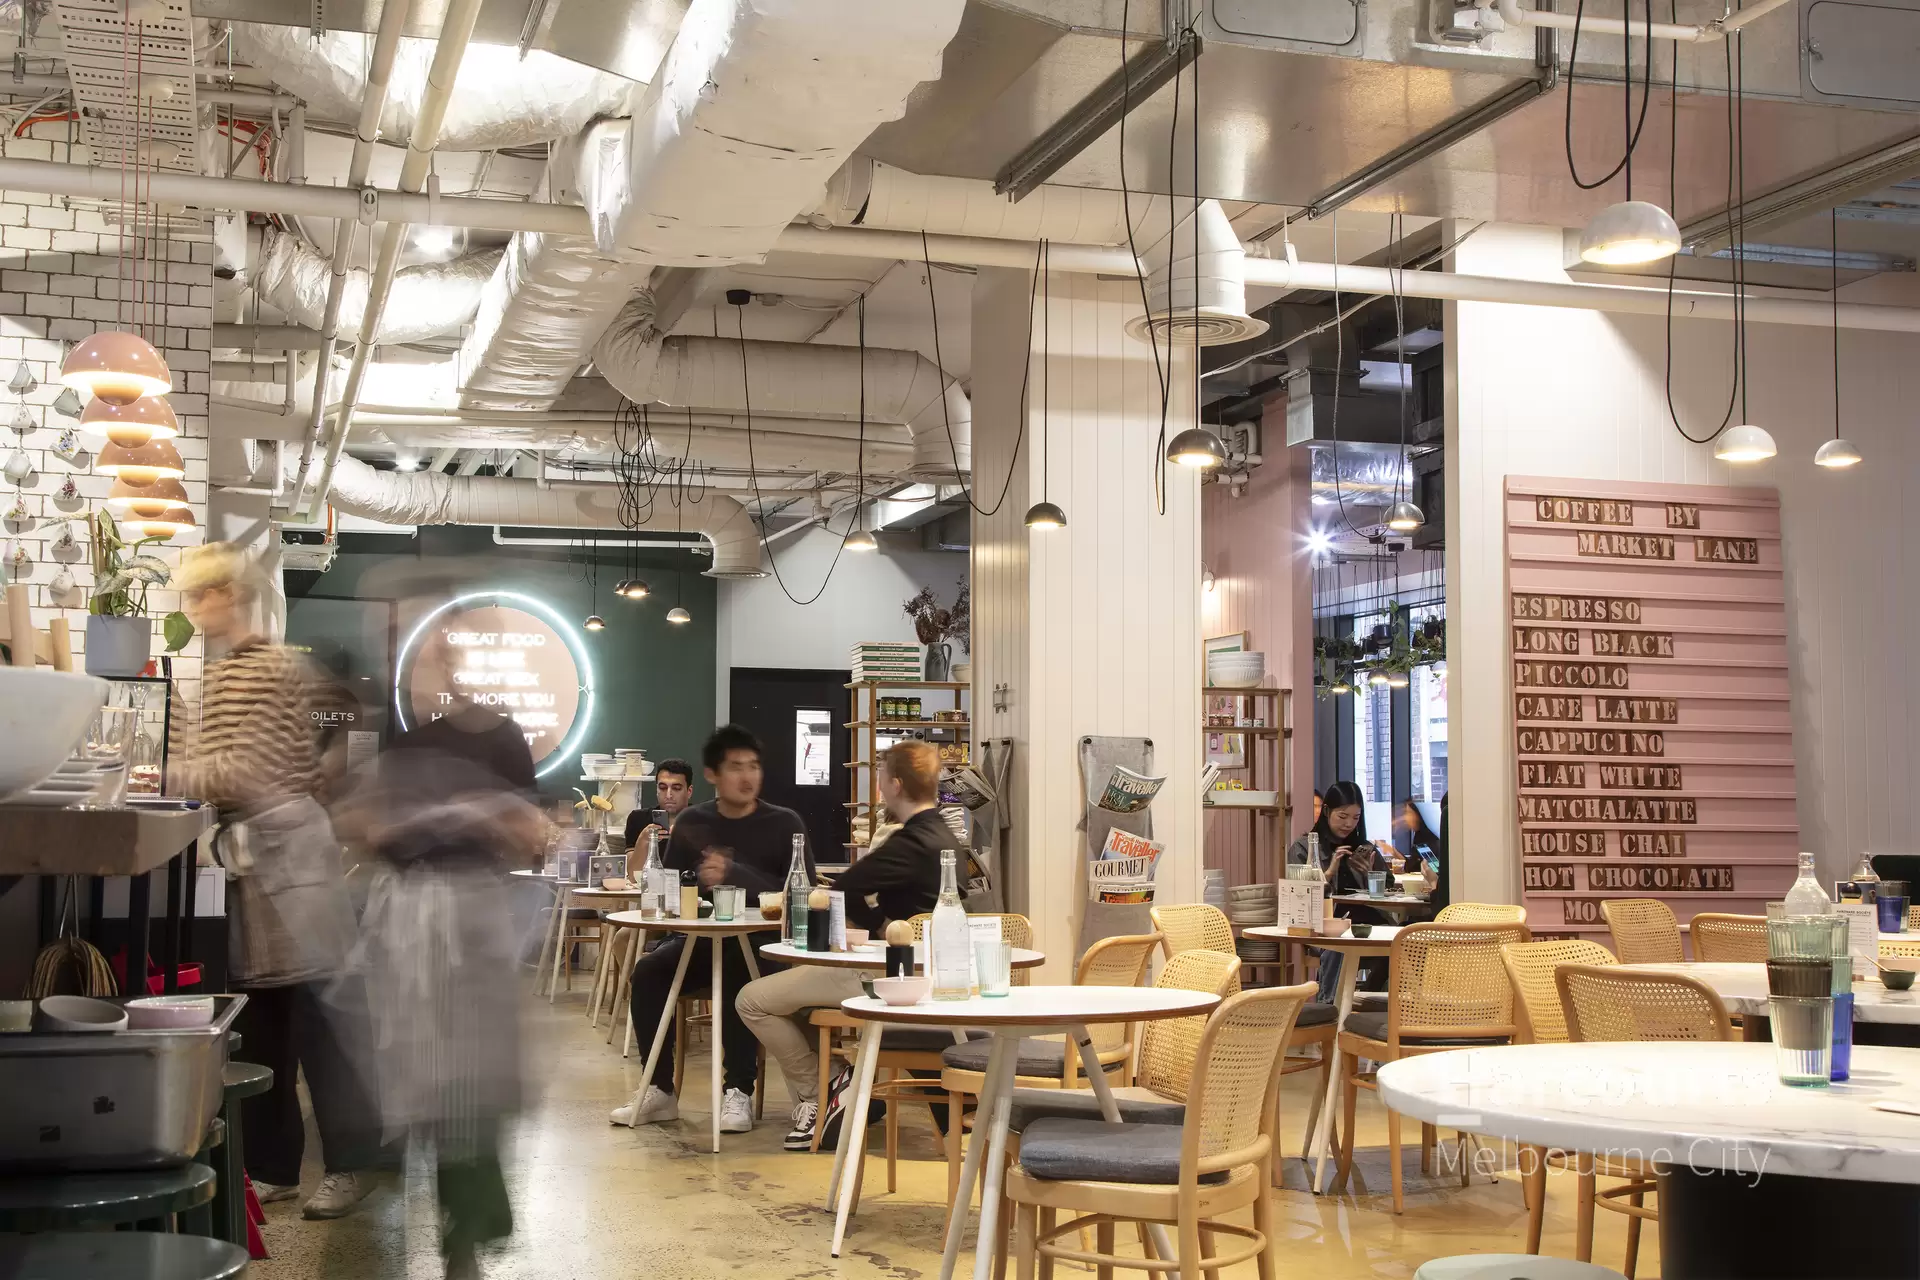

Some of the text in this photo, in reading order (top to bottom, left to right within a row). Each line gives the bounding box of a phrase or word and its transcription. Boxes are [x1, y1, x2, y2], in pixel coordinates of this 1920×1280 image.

[1538, 499, 1698, 526] COFFEE BY
[1578, 533, 1757, 561] MARKET LANE
[1513, 597, 1641, 620] ESPRESSO
[1515, 630, 1673, 655] LONG BLACK
[1515, 663, 1628, 687] PICCOLO
[473, 692, 520, 706] MORE
[522, 692, 556, 707] YOU
[1518, 697, 1676, 721] CAFE LATTE
[308, 711, 355, 721] OILETS
[1519, 731, 1664, 753] CAPPUCINO
[1521, 764, 1681, 788] FLAT WHITE
[1519, 797, 1695, 820] MATCHALATTE
[1111, 831, 1160, 864] Traveller
[1522, 832, 1684, 855] HOUSE CHAI
[1094, 858, 1147, 878] GOURMET
[1525, 866, 1733, 888] HOT CHOCOLATE
